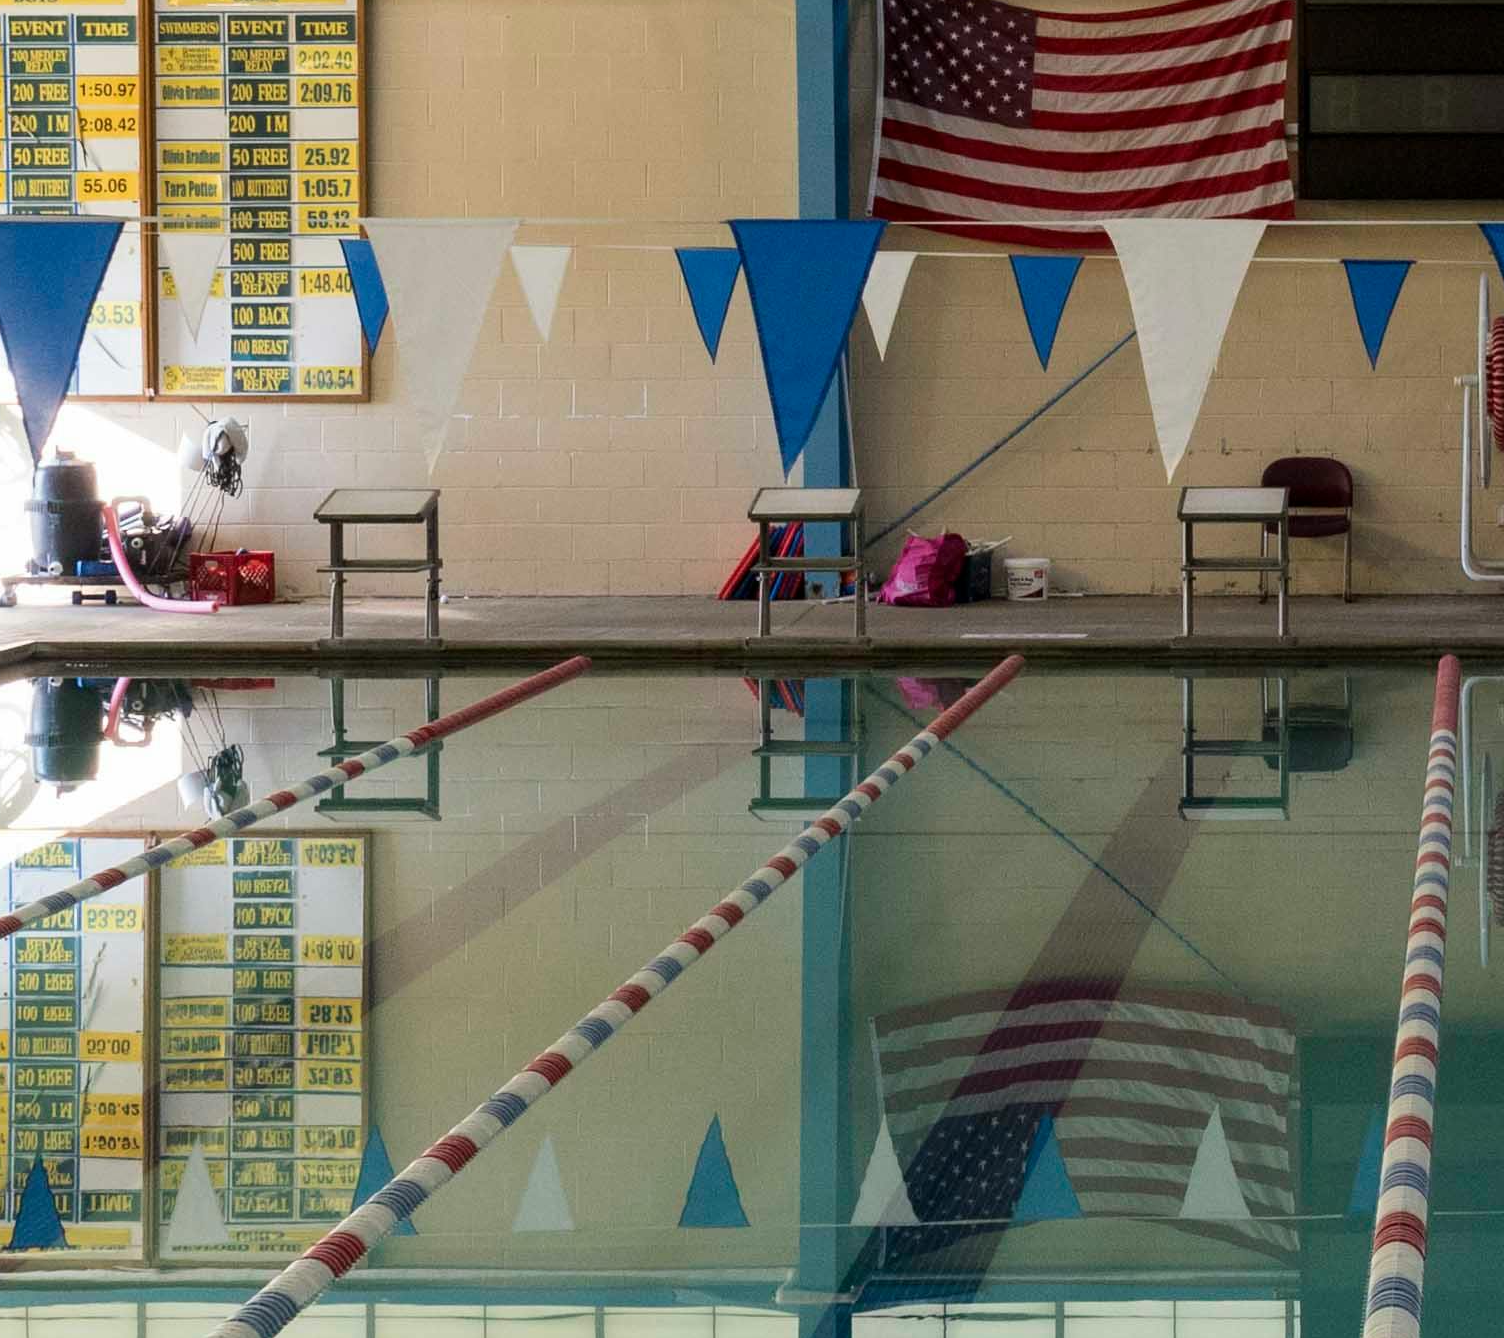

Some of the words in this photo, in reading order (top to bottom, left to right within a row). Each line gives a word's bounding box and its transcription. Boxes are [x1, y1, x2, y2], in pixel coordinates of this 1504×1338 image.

[11, 20, 66, 37] EVENT
[82, 22, 129, 37] TIME
[159, 21, 220, 36] SWIMMER(S)
[230, 20, 285, 36] EVENT
[301, 21, 348, 36] TIME
[12, 49, 30, 61] 200
[31, 49, 68, 61] MEDLEY
[231, 49, 249, 61] 200
[250, 49, 288, 61] MEDLEY
[298, 51, 352, 70] 2:02.40
[25, 61, 54, 72] RELAY
[244, 61, 274, 72] RELAY
[13, 84, 34, 101] 200
[39, 84, 69, 101] FREE
[80, 83, 137, 97] 1:50.97
[232, 84, 252, 101] 200
[258, 84, 288, 101] FREE
[301, 83, 352, 102] 2:09.76
[12, 115, 37, 132] 200
[80, 118, 136, 132] 2:08.42
[231, 115, 255, 132] 200
[14, 148, 31, 165] 50
[34, 148, 69, 165] FREE
[232, 149, 249, 165] 50
[253, 149, 288, 165] FREE
[305, 148, 350, 165] 25.92
[14, 179, 27, 197] 100
[29, 179, 69, 197] BUTTERFLY
[83, 179, 127, 193] 55.06
[165, 181, 186, 197] Tara
[189, 181, 217, 197] Potter
[232, 180, 245, 197] 100
[247, 179, 288, 197] BUTTERFLY
[304, 179, 351, 197] 1:05.7
[232, 212, 253, 229] 100
[258, 212, 288, 229] FREE
[234, 243, 254, 260] 500
[260, 243, 289, 260] FREE
[233, 272, 255, 284] 200
[257, 272, 288, 284] FREE
[301, 273, 353, 292] 1:48.40
[241, 283, 280, 295] RELAY
[91, 304, 135, 324] 3.53
[234, 307, 253, 325] 100
[259, 307, 289, 325] BACK
[234, 340, 249, 354] 100
[252, 340, 288, 354] BREAST
[234, 369, 255, 380] 400
[261, 369, 289, 380] FREE
[304, 370, 354, 389] 4:03.54
[244, 380, 280, 390] RELAY
